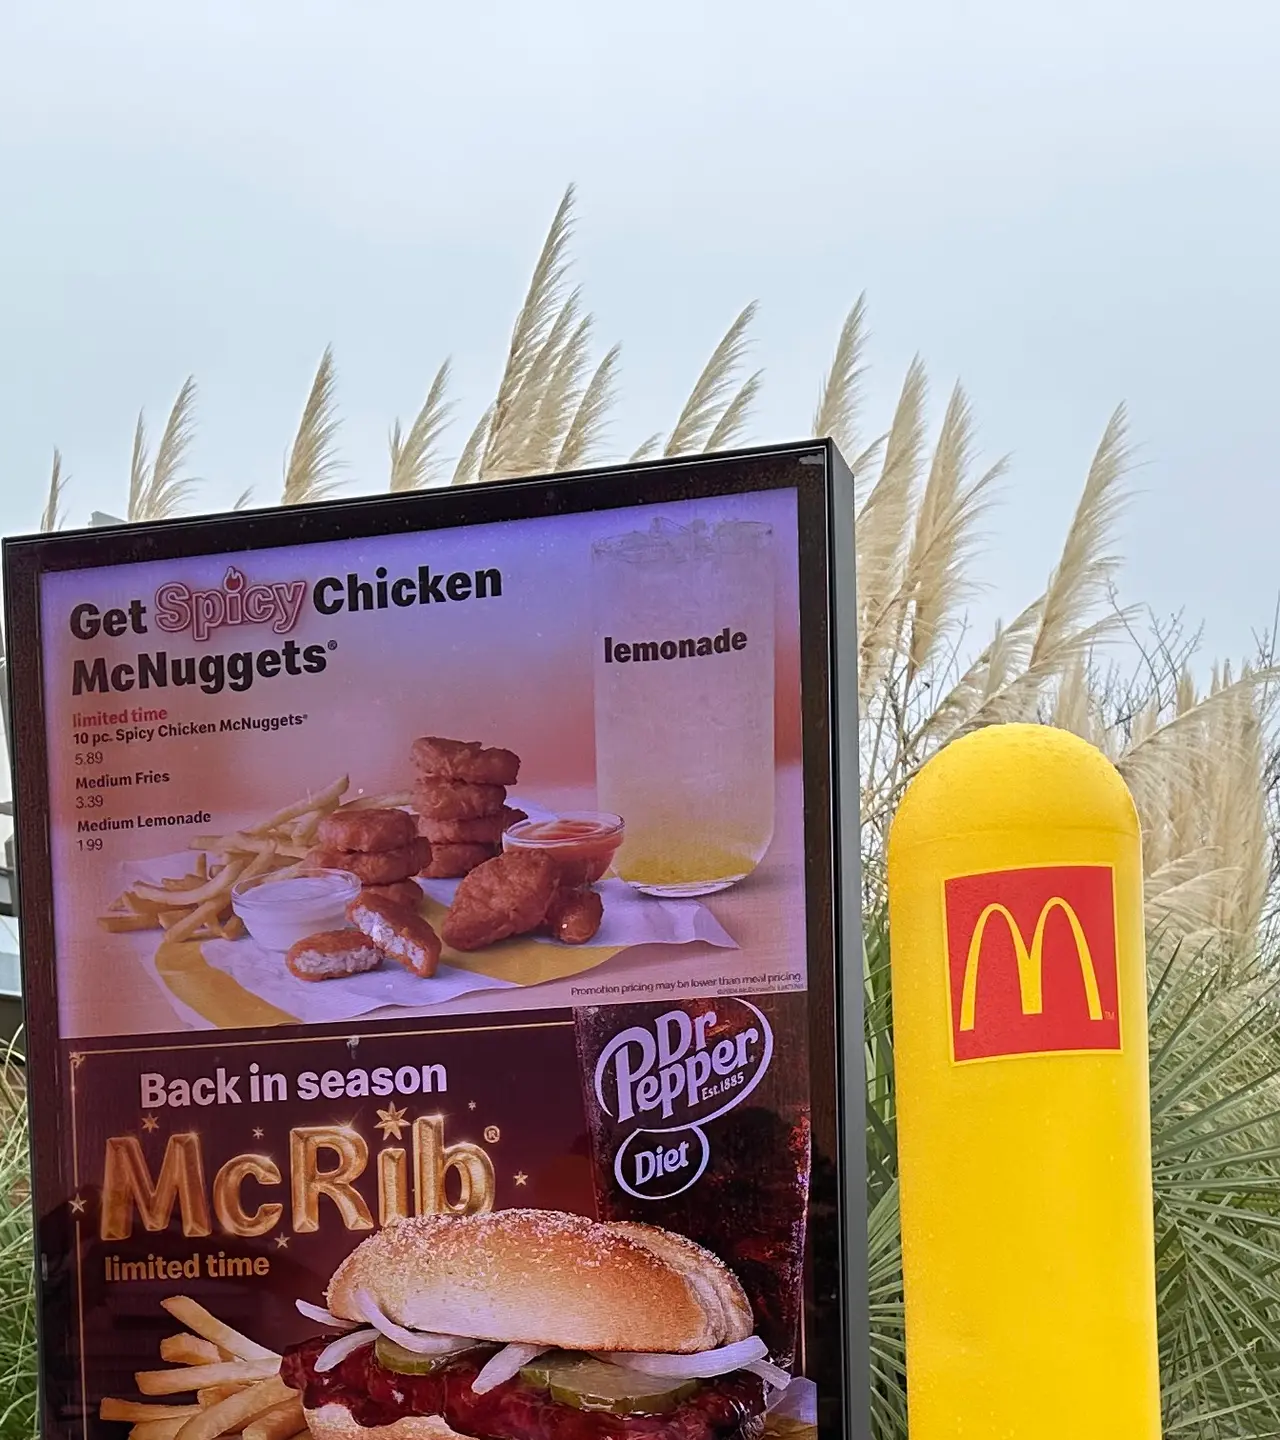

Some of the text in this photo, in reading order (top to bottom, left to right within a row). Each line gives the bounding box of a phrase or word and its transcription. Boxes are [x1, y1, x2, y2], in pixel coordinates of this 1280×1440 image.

[70, 563, 503, 642] Get Spicy Chicken
[604, 626, 749, 665] lemonade
[72, 706, 168, 728] limited time
[73, 731, 89, 745] 10
[115, 727, 155, 744] Spicy
[158, 721, 217, 738] Chicken
[74, 751, 104, 766] 5.89
[75, 770, 171, 790] Medium Fries
[75, 795, 104, 809] 3.39
[77, 810, 212, 833] Medium Lemonade
[571, 984, 620, 996] Promotion
[621, 983, 654, 995] pricing
[655, 981, 676, 992] may
[691, 977, 717, 988] lower
[718, 976, 741, 986] than
[742, 973, 766, 984] meal
[654, 1009, 718, 1070] Dr
[141, 1062, 448, 1108] Back in season
[595, 1025, 760, 1125] Pepper
[634, 1139, 690, 1186] Diet
[105, 1251, 271, 1282] limited time
